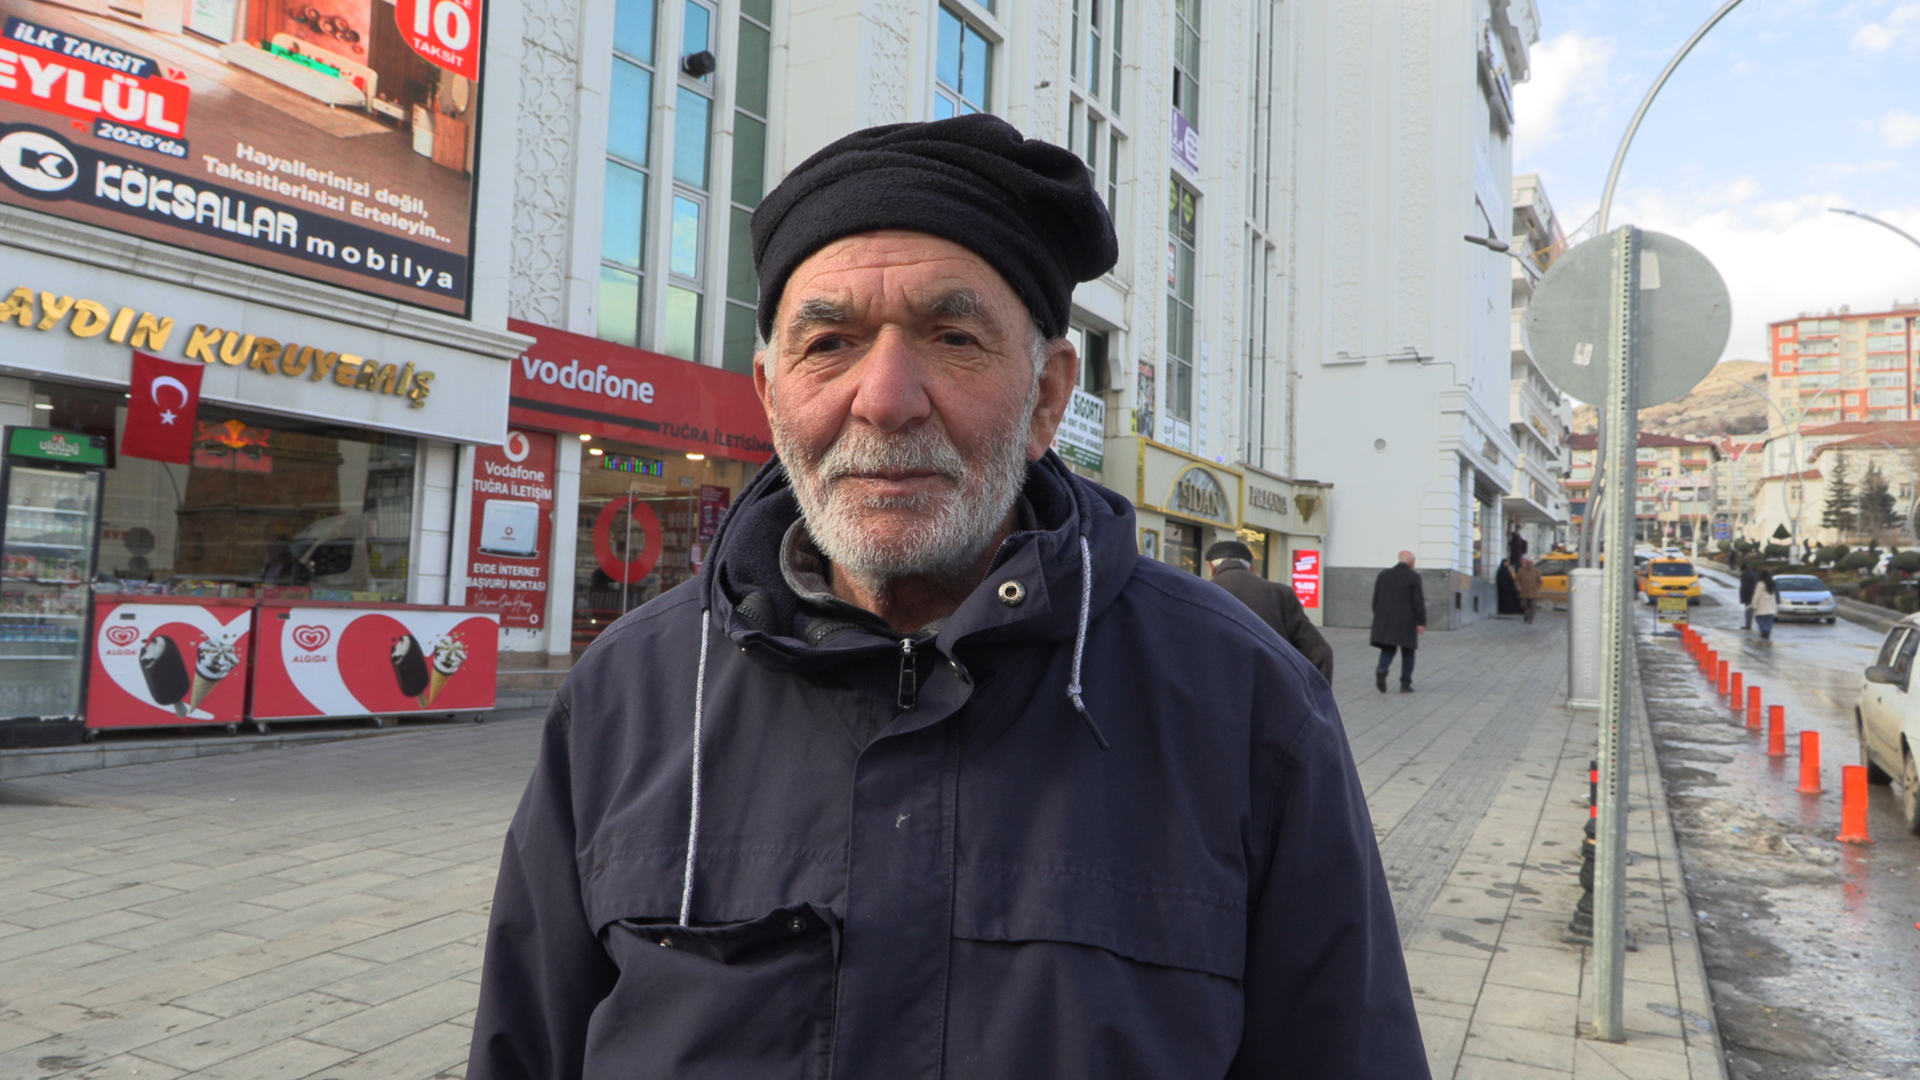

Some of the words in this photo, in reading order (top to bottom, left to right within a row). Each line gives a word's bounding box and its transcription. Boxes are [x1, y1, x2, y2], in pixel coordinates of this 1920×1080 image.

[14, 23, 58, 49] İLK
[64, 36, 146, 75] TAKSİT
[415, 0, 470, 51] 10
[413, 37, 464, 67] TAKSİT
[0, 48, 179, 134] EYLÜL
[97, 122, 185, 157] 2026'da
[203, 154, 345, 212] Taksitlerinizi
[350, 200, 451, 243] Erteleyin...
[236, 142, 370, 198] Hayallerinizi
[375, 188, 429, 219] değil,
[95, 160, 298, 248] KÖKSALLAR
[306, 235, 453, 289] mobilya
[0, 284, 175, 351] AYDIN
[185, 323, 436, 408] KURUYEMİŞ
[520, 355, 654, 404] vodafone
[661, 421, 709, 443] TUĞRA
[714, 428, 767, 452] İLETİŞİM
[473, 478, 509, 495] TUĞRA
[510, 481, 553, 502] İLETİŞİM
[484, 460, 545, 482] Vodafone
[473, 563, 497, 575] EVDE
[498, 562, 540, 578] İNTERNET
[509, 580, 546, 592] NOKTASI
